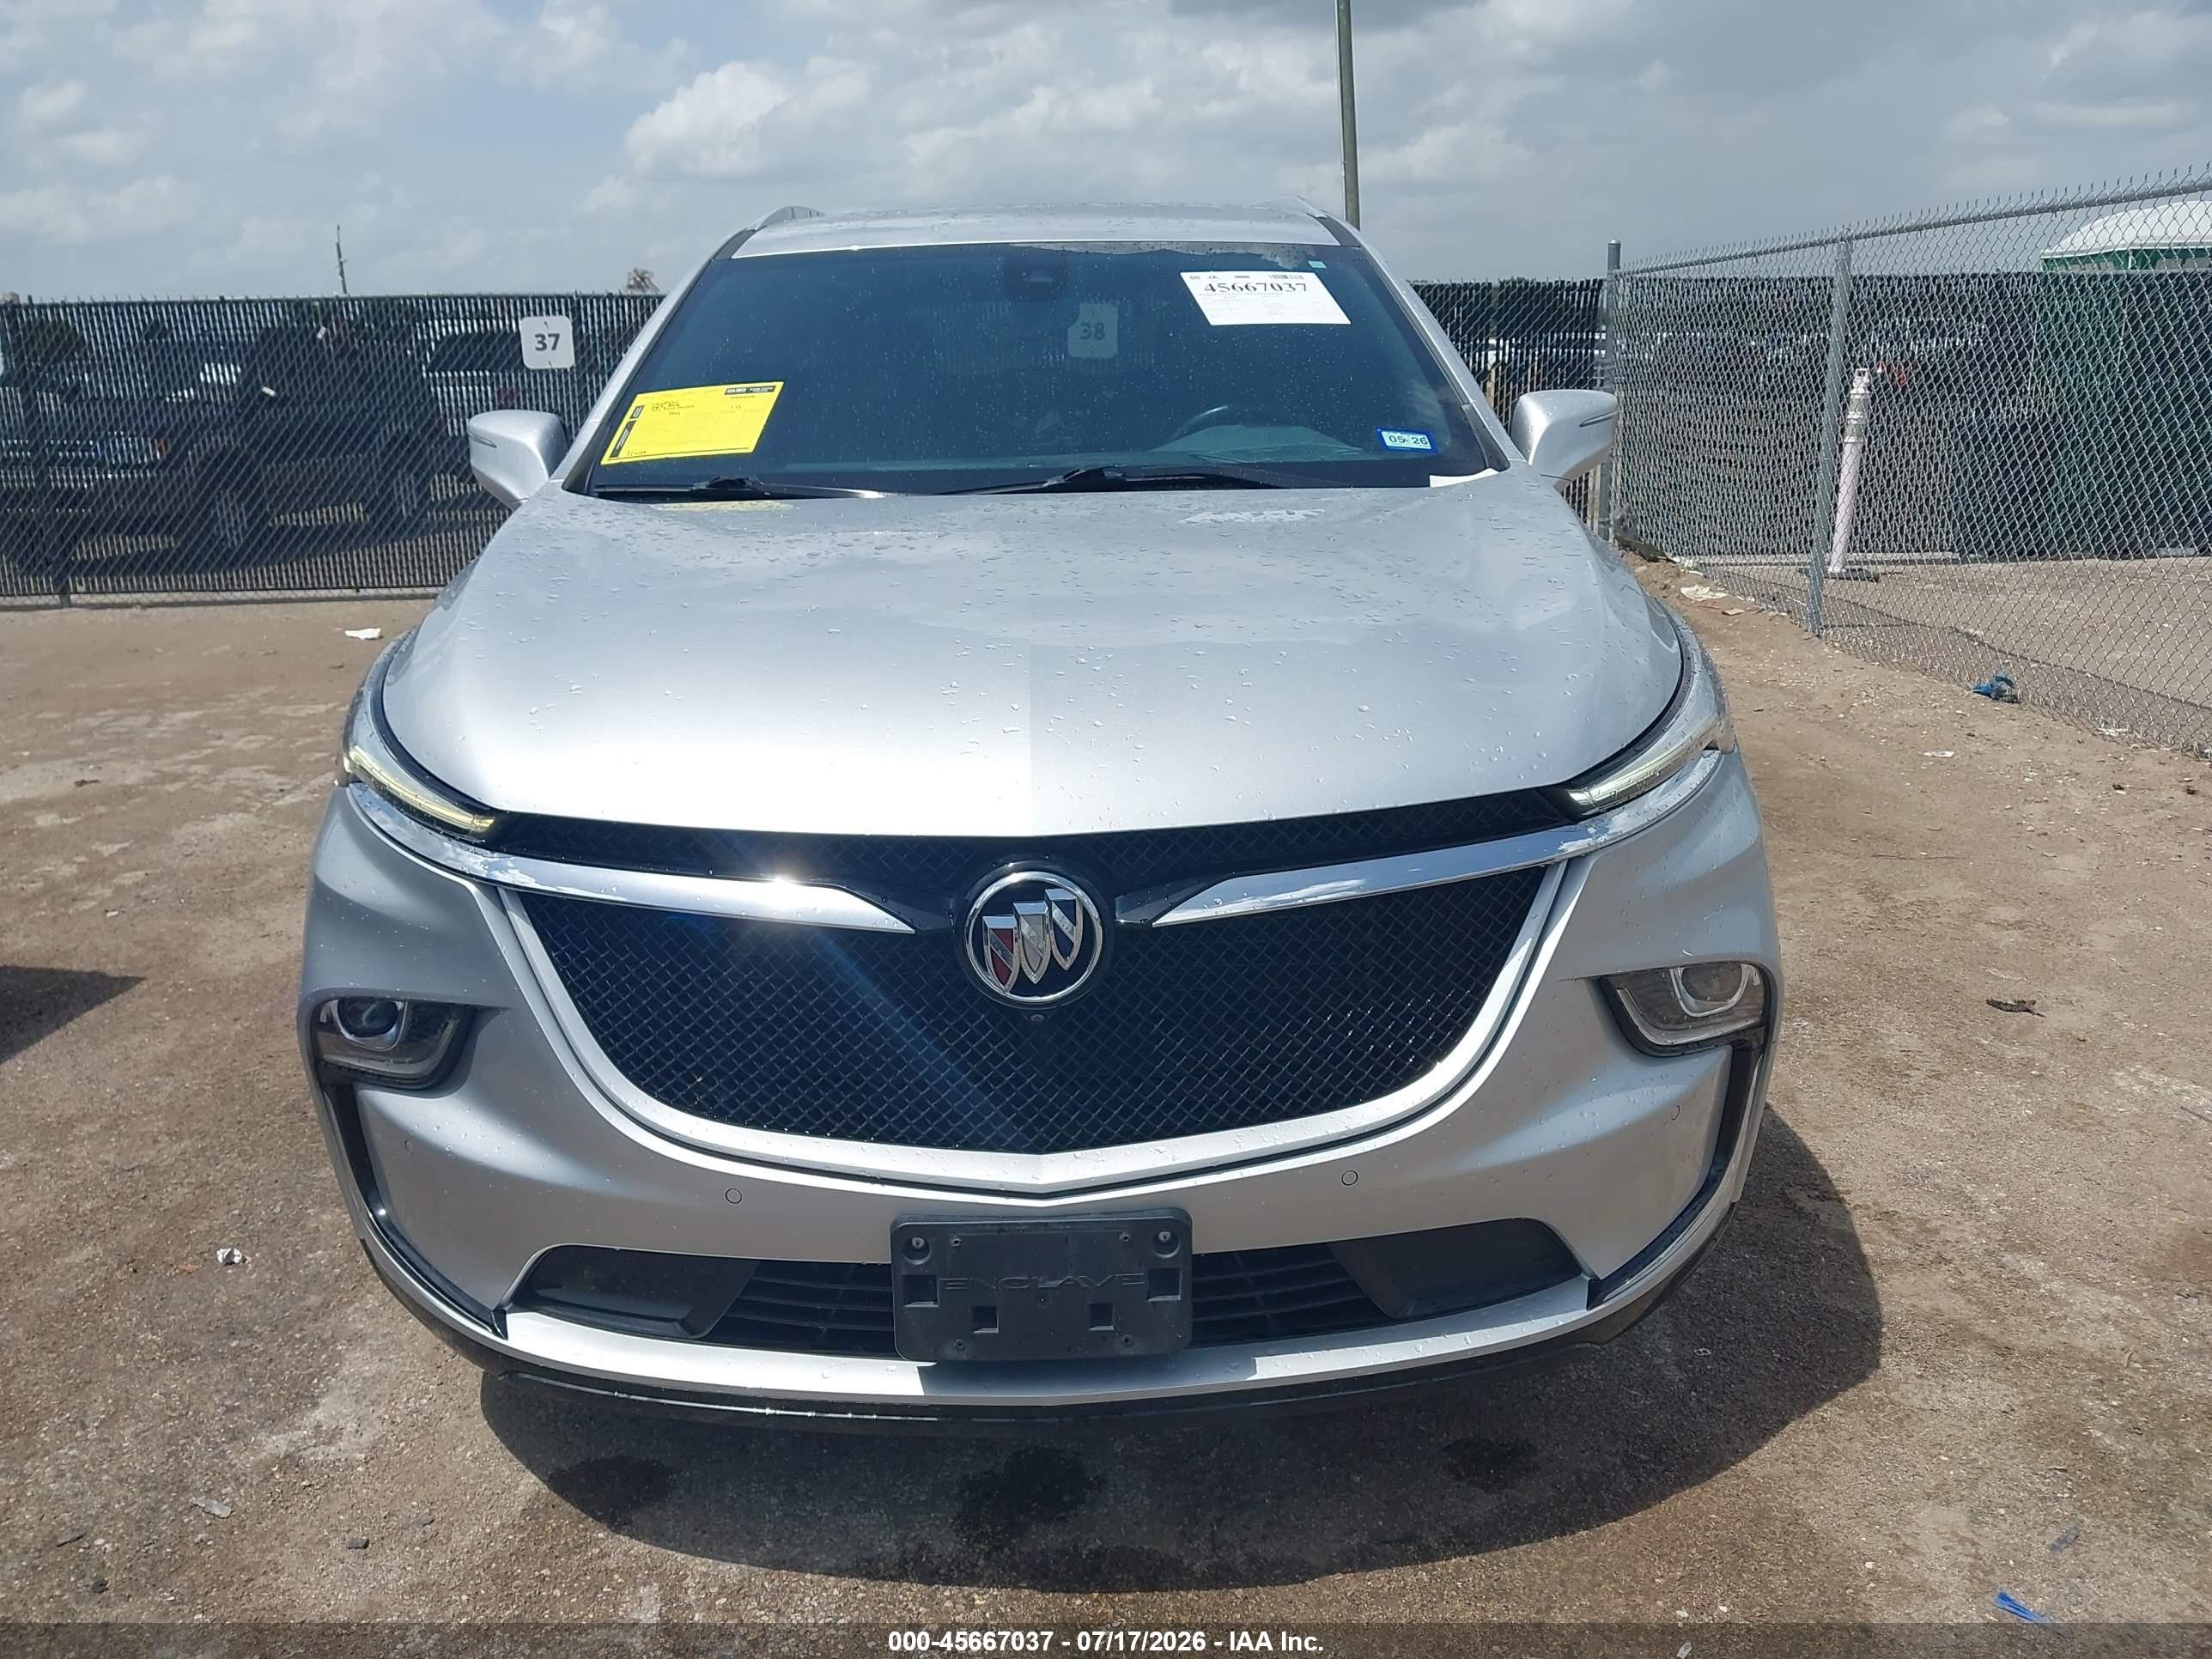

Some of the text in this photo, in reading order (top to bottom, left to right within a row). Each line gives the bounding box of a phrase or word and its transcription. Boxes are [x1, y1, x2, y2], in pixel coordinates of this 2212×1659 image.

[1204, 283, 1307, 294] 45667037
[1080, 322, 1106, 340] 38
[534, 333, 560, 351] 37
